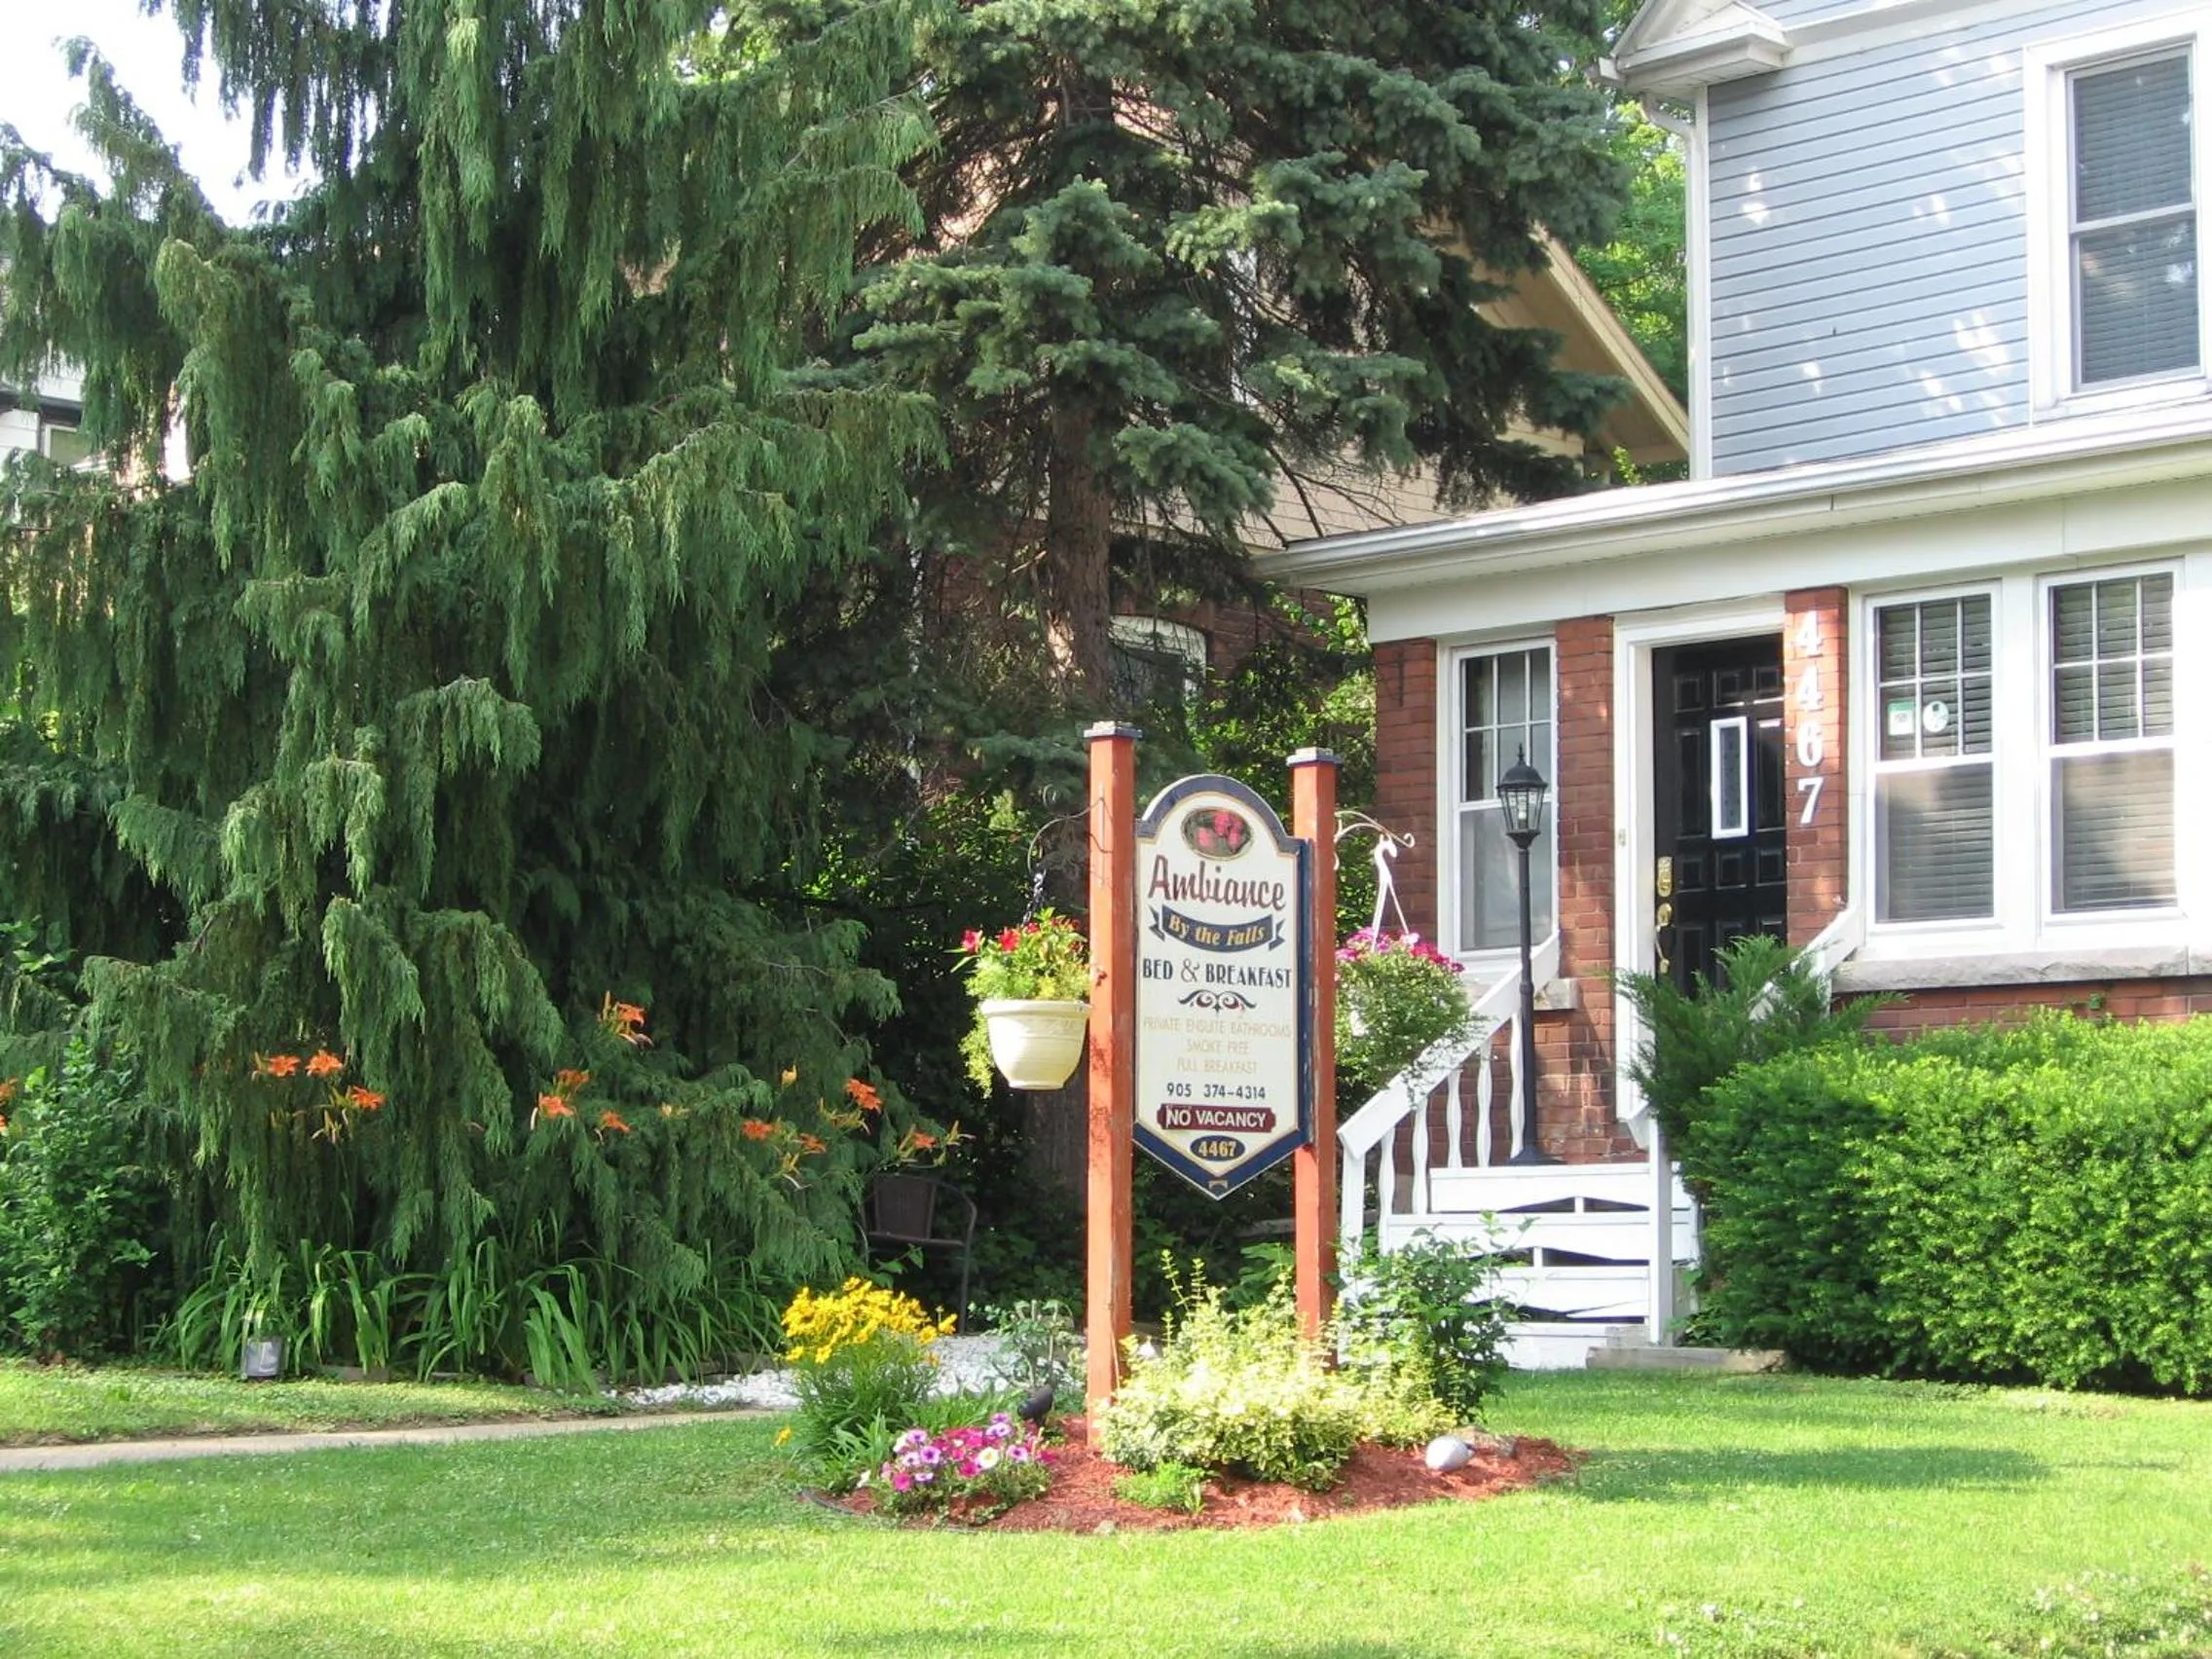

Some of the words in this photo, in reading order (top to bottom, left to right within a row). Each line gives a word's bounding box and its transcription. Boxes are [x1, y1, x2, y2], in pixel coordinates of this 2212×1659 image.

[1795, 609, 1824, 825] 4467
[1148, 854, 1286, 911] Ambiance
[1168, 914, 1190, 939] By
[1195, 926, 1221, 946] the
[1226, 926, 1265, 946] Falls
[1143, 958, 1173, 980] BED
[1180, 958, 1200, 983] &
[1205, 964, 1292, 988] BREAKFAST
[1144, 1016, 1181, 1032] PRIVATE
[1186, 1018, 1225, 1035] ENSUITE
[1231, 1021, 1292, 1038] BATHROOMS
[1187, 1039, 1222, 1053] SMOKE
[1228, 1041, 1250, 1054] FREE
[1177, 1057, 1198, 1072] FULL
[1204, 1058, 1258, 1074] BREAKFAST
[1166, 1082, 1192, 1097] 905
[1203, 1084, 1266, 1099] 374-4314
[1167, 1109, 1191, 1126] NO
[1196, 1111, 1267, 1127] VACANCY
[1198, 1141, 1236, 1157] 4467
